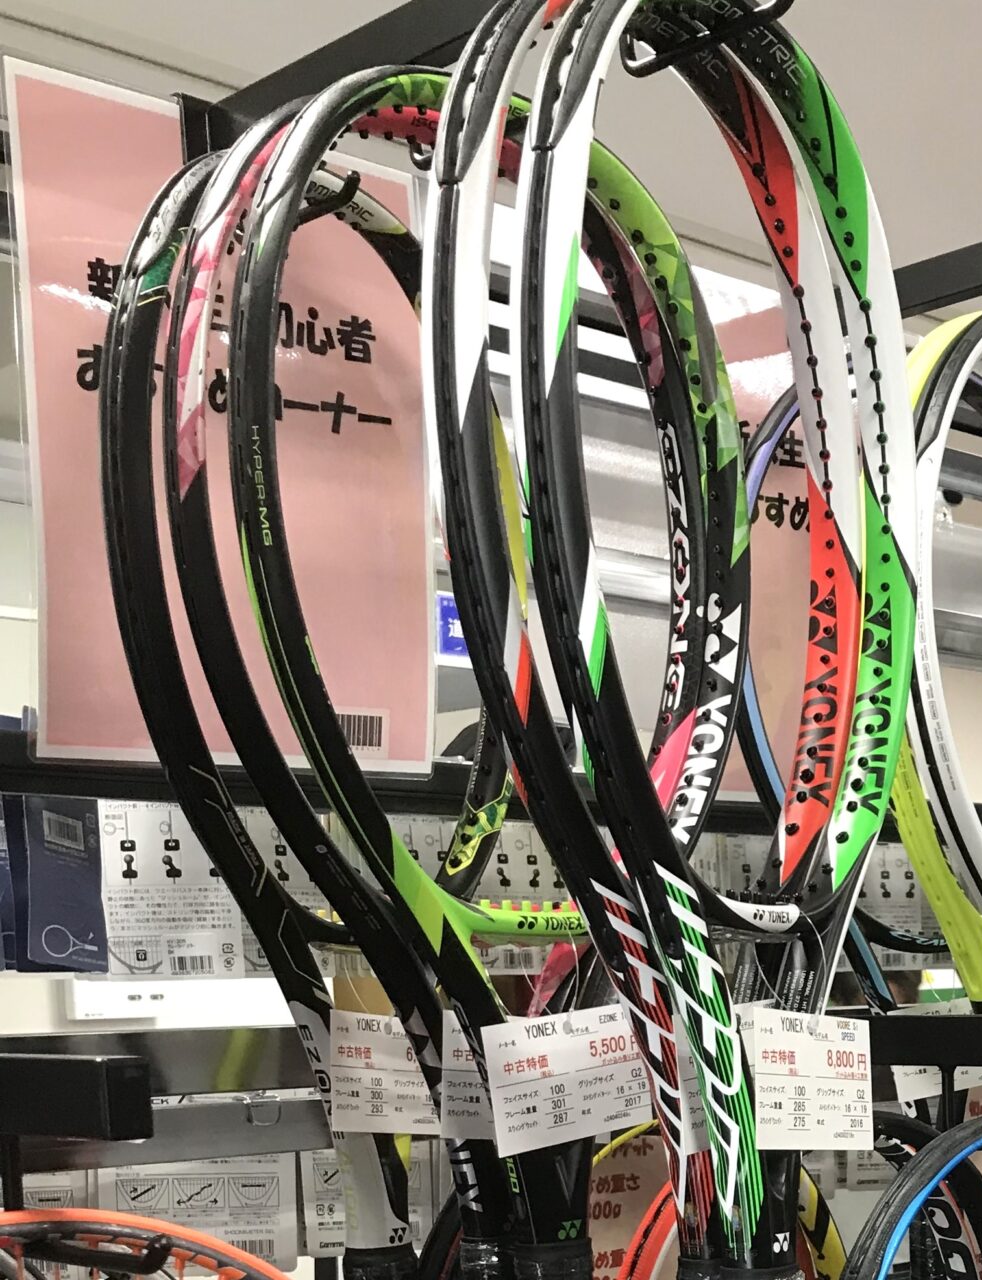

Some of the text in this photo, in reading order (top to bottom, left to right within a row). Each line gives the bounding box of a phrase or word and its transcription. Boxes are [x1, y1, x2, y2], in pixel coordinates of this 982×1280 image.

[251, 425, 273, 546] HYPER-MG
[798, 666, 839, 808] YONEX
[843, 677, 892, 817] YONEX
[668, 692, 732, 846] YONEX
[541, 916, 585, 930] YONEX
[767, 909, 792, 924] YONEX
[357, 1018, 381, 1033] YONEX
[599, 1013, 618, 1024] EZONE
[781, 1017, 804, 1033] YONEX
[525, 1022, 557, 1040] YONEX
[338, 1044, 372, 1059] 中古特価
[504, 1035, 626, 1075] 中古特価 5,500
[762, 1049, 867, 1070] 中古特価 8,800 円
[371, 1078, 382, 1086] 100
[578, 1068, 642, 1088] グリップサイズ G2
[371, 1091, 383, 1100] 300
[504, 1084, 566, 1104] フェイスサイズ 100
[794, 1086, 805, 1096] 100
[817, 1088, 865, 1099] グリップサイズ G2
[371, 1105, 383, 1113] 293
[505, 1099, 566, 1118] フレーム重量 301
[625, 1096, 642, 1108] 2017
[760, 1101, 805, 1112] フレーム重量 285
[861, 1104, 867, 1114] 19
[553, 1113, 568, 1125] 287
[794, 1117, 805, 1127] 275
[850, 1119, 863, 1128] 2016
